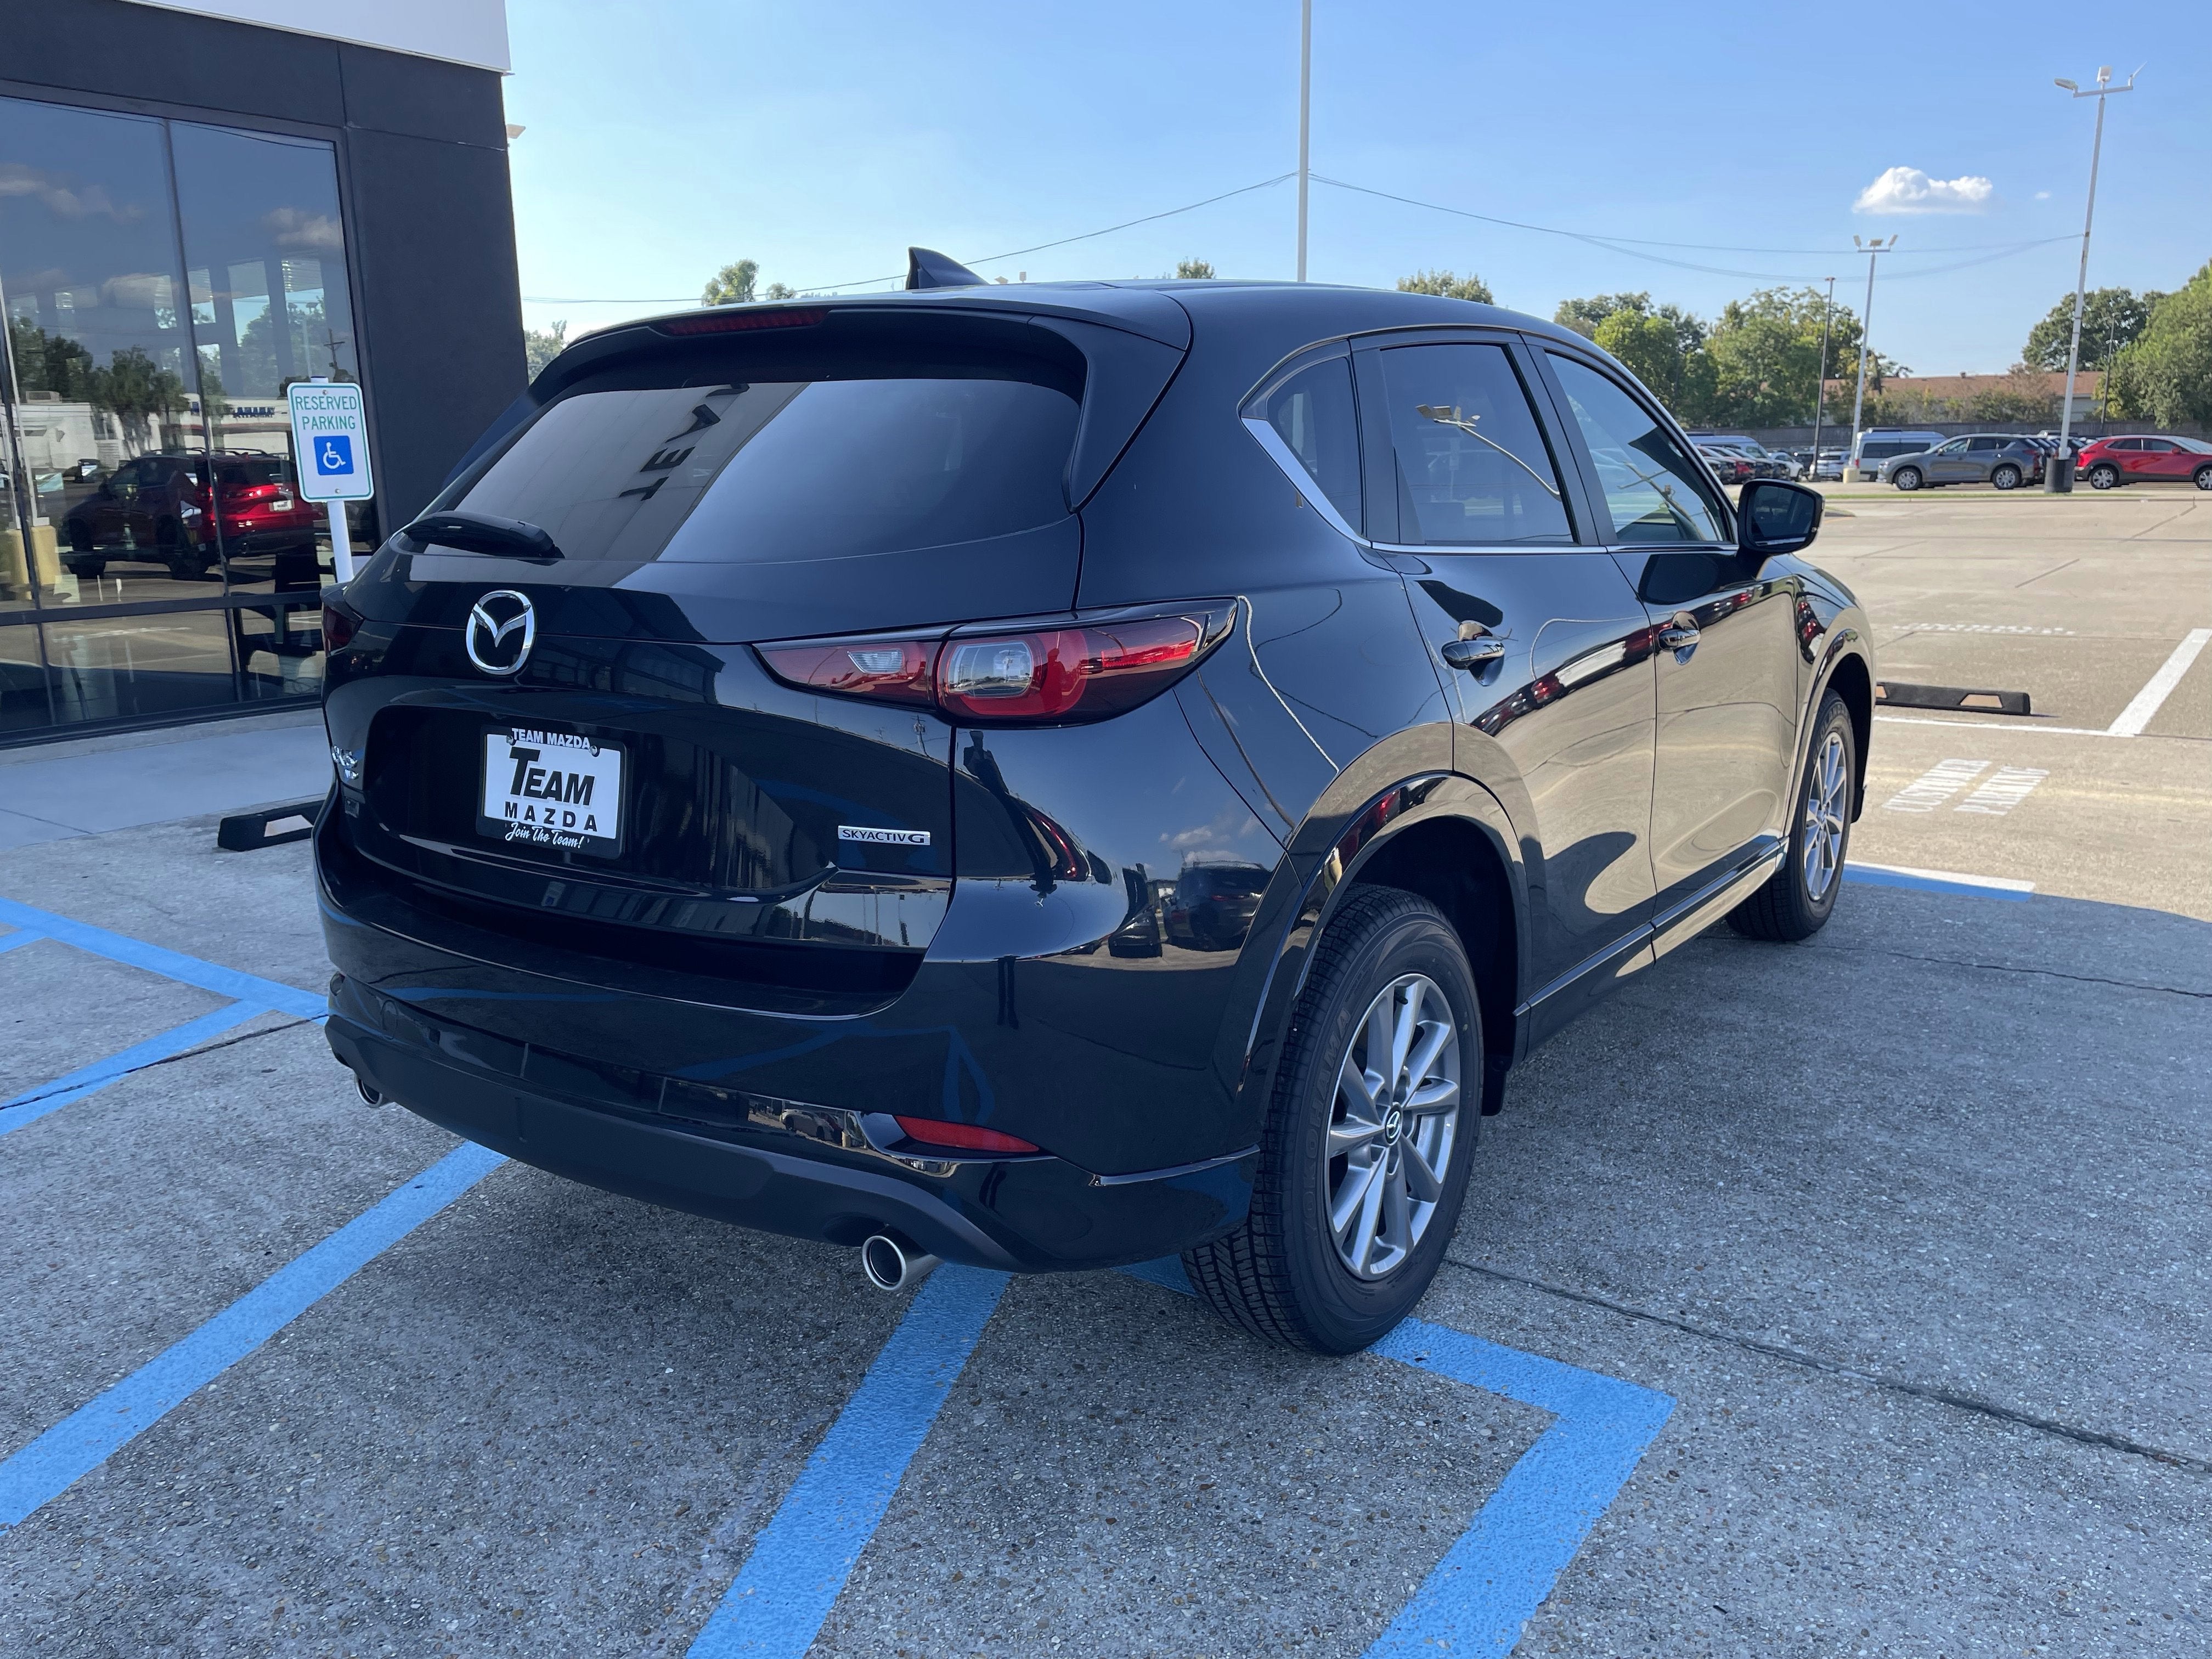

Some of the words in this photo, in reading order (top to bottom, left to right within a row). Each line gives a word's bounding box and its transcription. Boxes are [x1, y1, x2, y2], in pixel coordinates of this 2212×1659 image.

[295, 396, 357, 410] RESERVED
[302, 416, 356, 430] PARKING
[511, 728, 543, 744] TEAM
[546, 732, 590, 749] MAZDA
[509, 746, 595, 806] TEAM
[1882, 758, 1992, 812] CUSTOMER
[1953, 766, 2050, 815] PARKING
[504, 801, 597, 832] MAZDA
[505, 822, 531, 841] Join
[532, 826, 550, 843] The
[551, 830, 585, 849] Team!
[1303, 1007, 1351, 1241] YOKOHAMA
